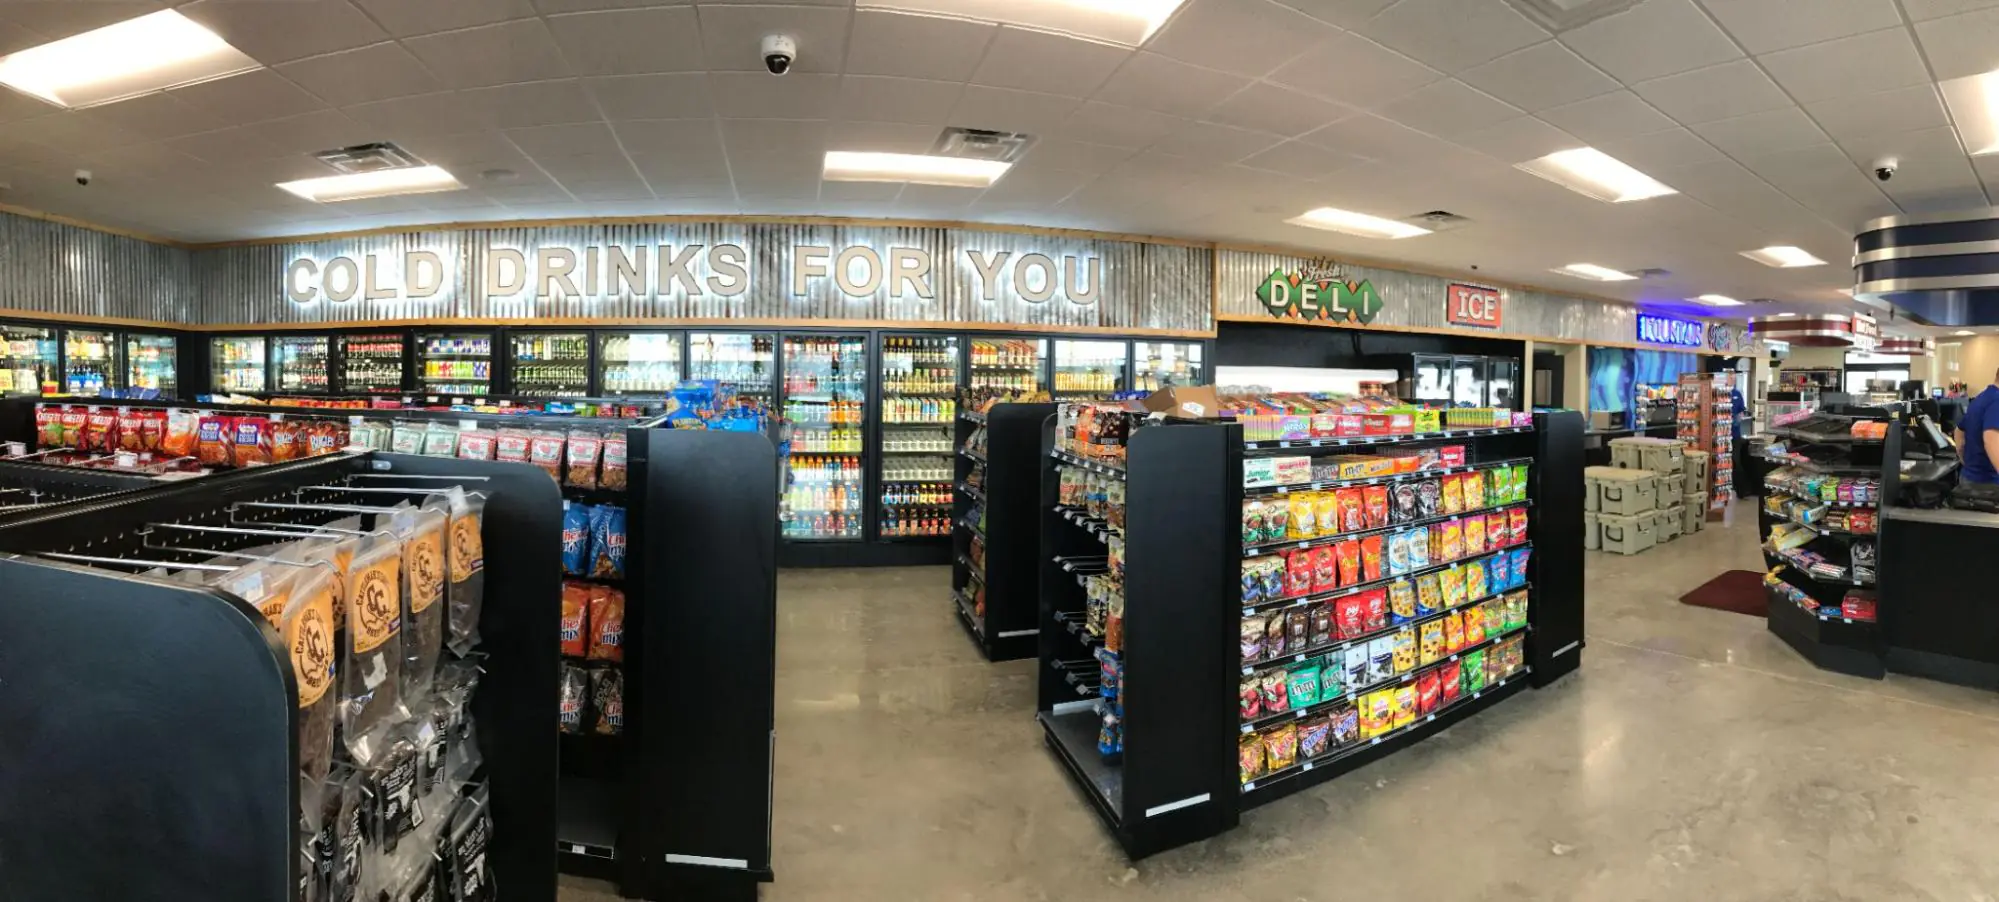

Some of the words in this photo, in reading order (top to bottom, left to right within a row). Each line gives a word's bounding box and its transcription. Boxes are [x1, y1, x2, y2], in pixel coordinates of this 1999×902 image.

[286, 251, 445, 302] COLD
[487, 244, 748, 298] DRINKS
[793, 245, 934, 299] FOR
[966, 250, 1101, 305] YOU
[1270, 279, 1369, 315] DELI
[1456, 291, 1496, 321] ICE
